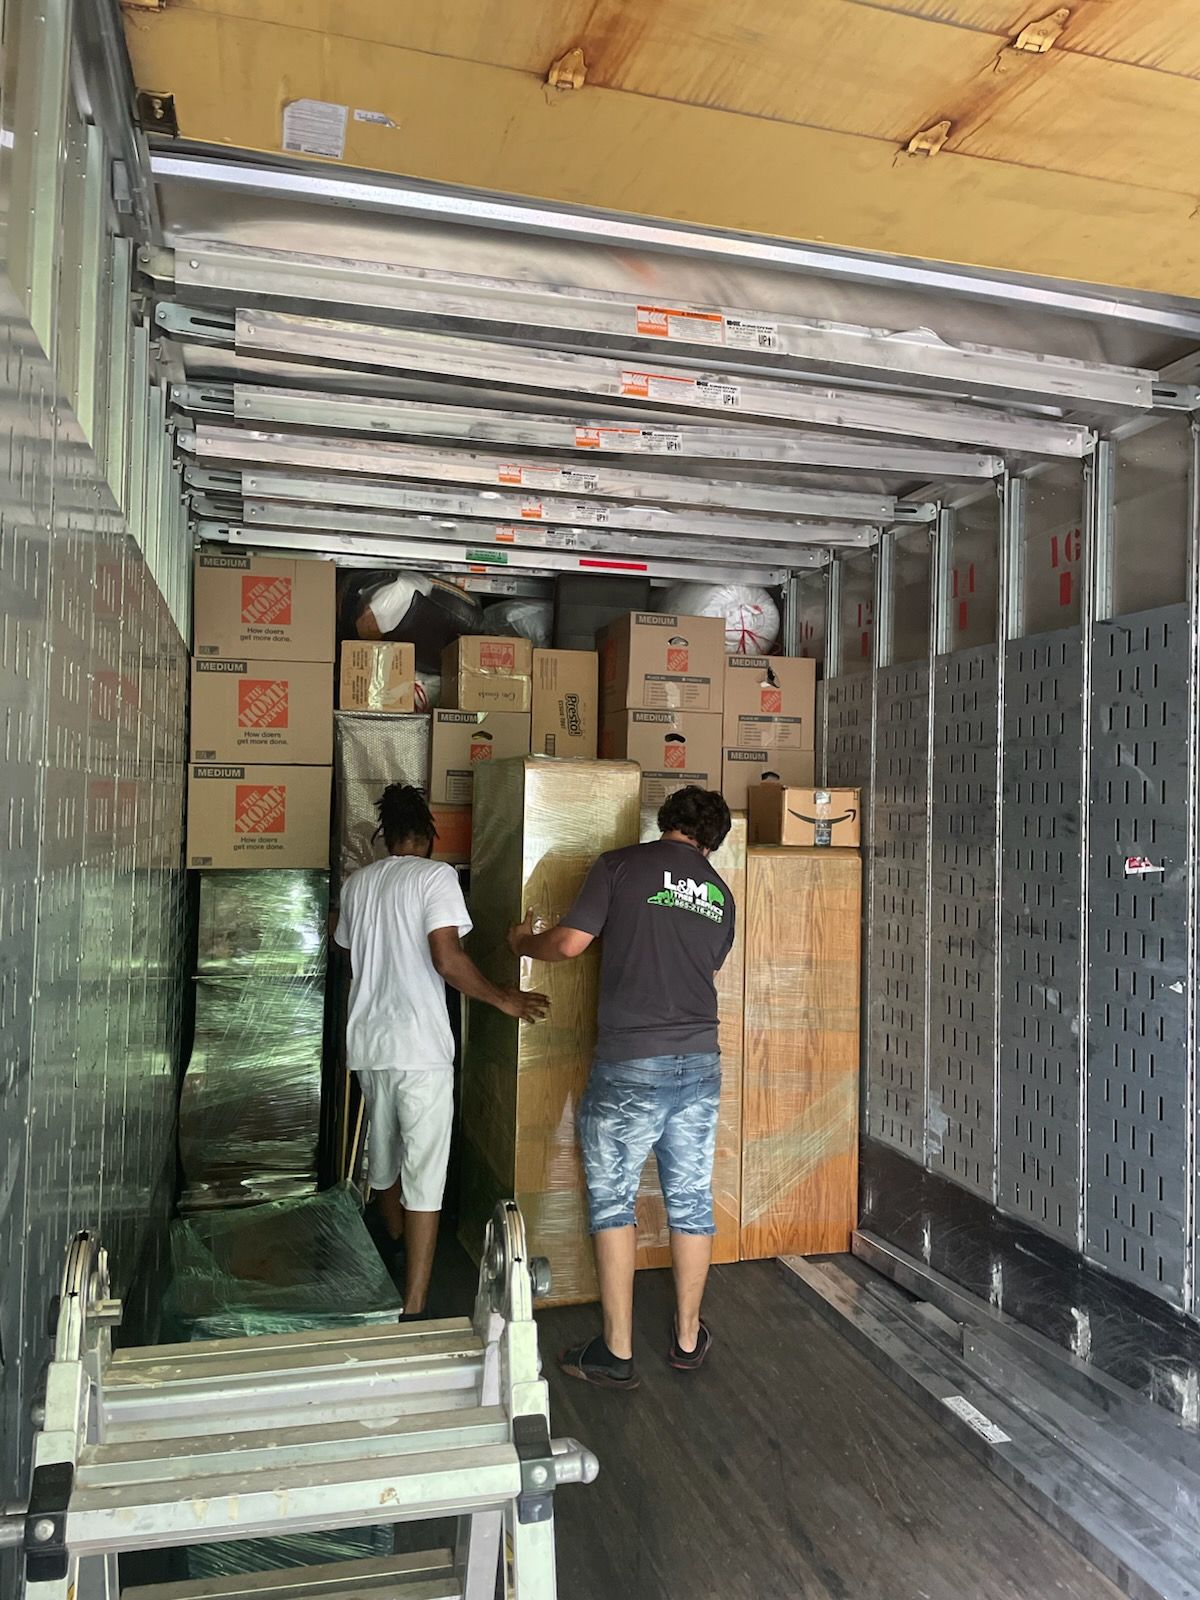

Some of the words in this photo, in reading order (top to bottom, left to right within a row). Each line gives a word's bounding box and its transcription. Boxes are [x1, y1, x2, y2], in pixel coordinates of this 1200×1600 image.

[203, 557, 247, 568] MEDIUM
[242, 577, 291, 623] HOME
[638, 616, 675, 625] MEDIUM
[264, 627, 284, 635] doers
[200, 662, 244, 672] MEDIUM
[731, 658, 766, 667] MEDIUM
[239, 681, 288, 727] HOME
[440, 714, 477, 722] MEDIUM
[567, 694, 581, 735] Presto!
[636, 713, 672, 722] MEDIUM
[730, 752, 765, 760] MEDIUM
[197, 768, 241, 777] MEDIUM
[236, 785, 286, 833] HOME
[664, 871, 708, 902] L&M
